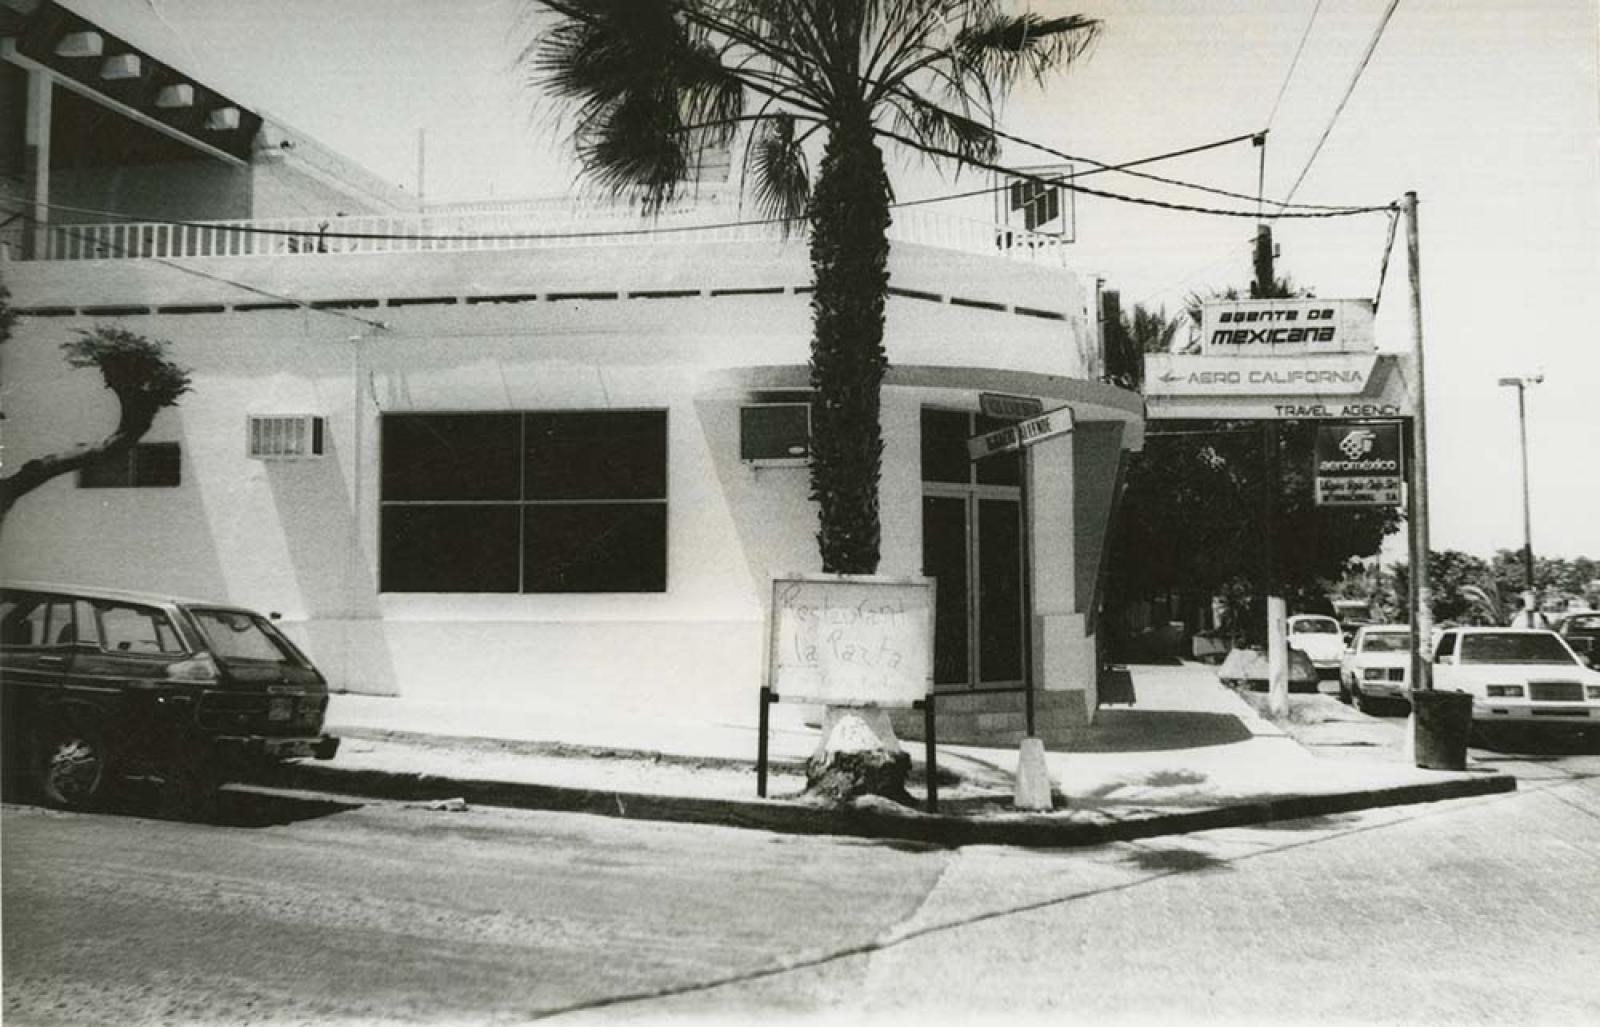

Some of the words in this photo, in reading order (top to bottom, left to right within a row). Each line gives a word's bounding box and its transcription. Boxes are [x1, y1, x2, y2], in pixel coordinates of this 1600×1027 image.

[1188, 371, 1241, 384] AERO
[1248, 369, 1363, 384] CALIFORNIA
[1275, 404, 1332, 417] TRAVEL
[1341, 404, 1400, 417] AGENCY
